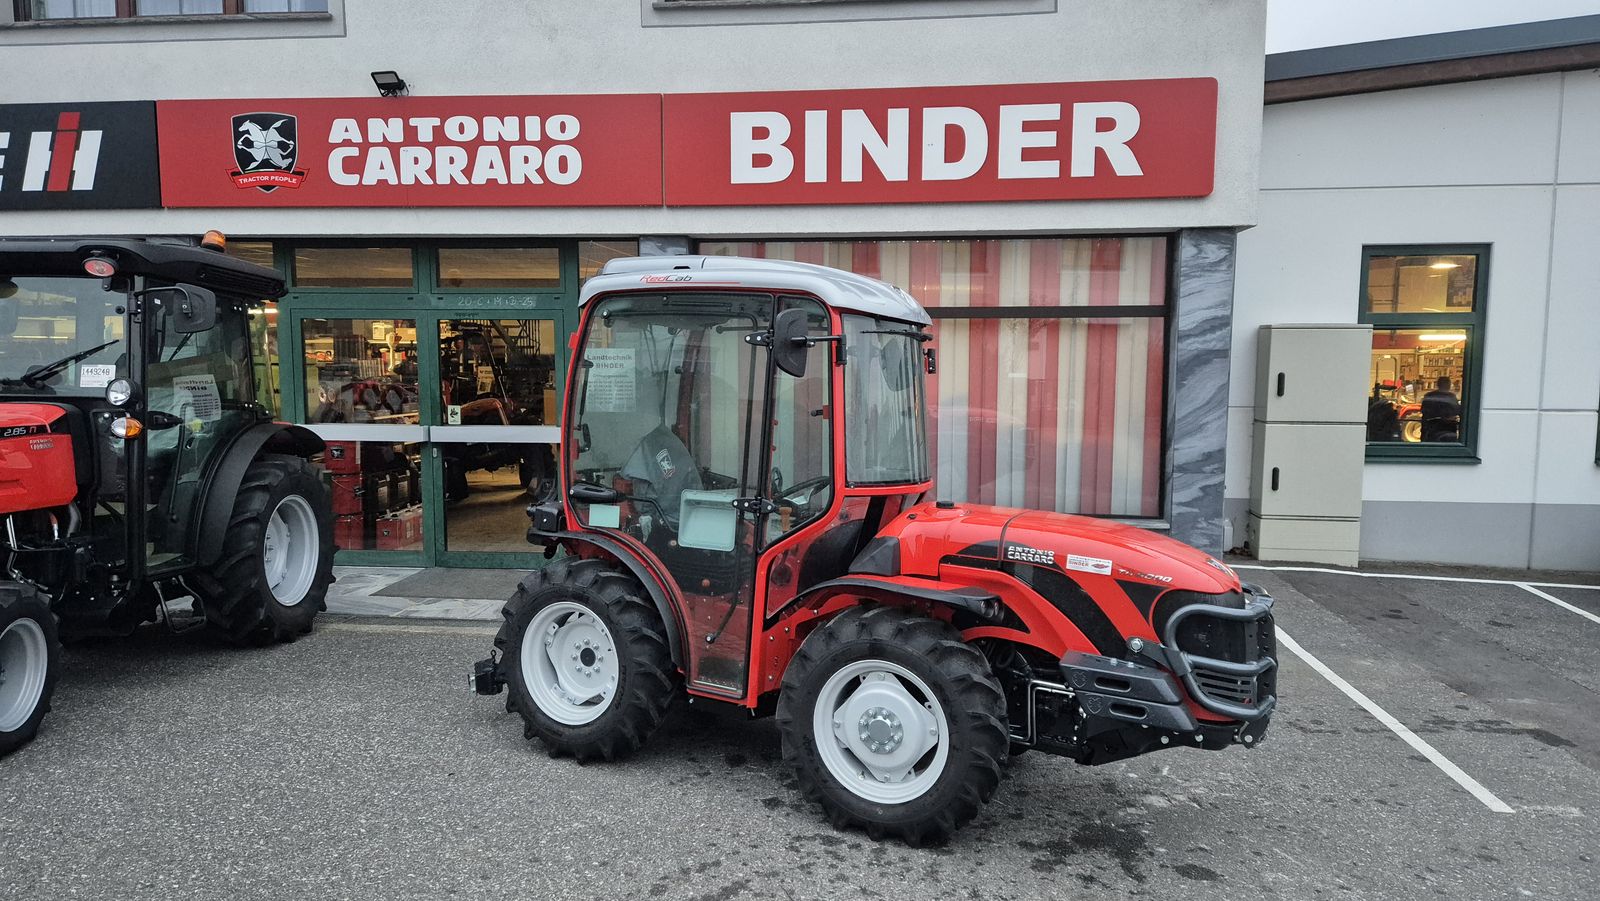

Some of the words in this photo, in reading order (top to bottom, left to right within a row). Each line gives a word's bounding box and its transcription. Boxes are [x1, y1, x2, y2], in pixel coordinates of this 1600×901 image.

[328, 114, 580, 143] ANTONIO
[730, 101, 1144, 184] BINDER
[327, 144, 582, 186] CARRARO
[238, 175, 269, 184] TRACTOR
[270, 175, 297, 184] PEOPLE
[640, 274, 692, 282] RedCab
[81, 367, 110, 376] 1449248
[3, 426, 27, 437] 2.85
[1008, 546, 1055, 556] ANTONIO
[1007, 551, 1054, 565] CARRARO
